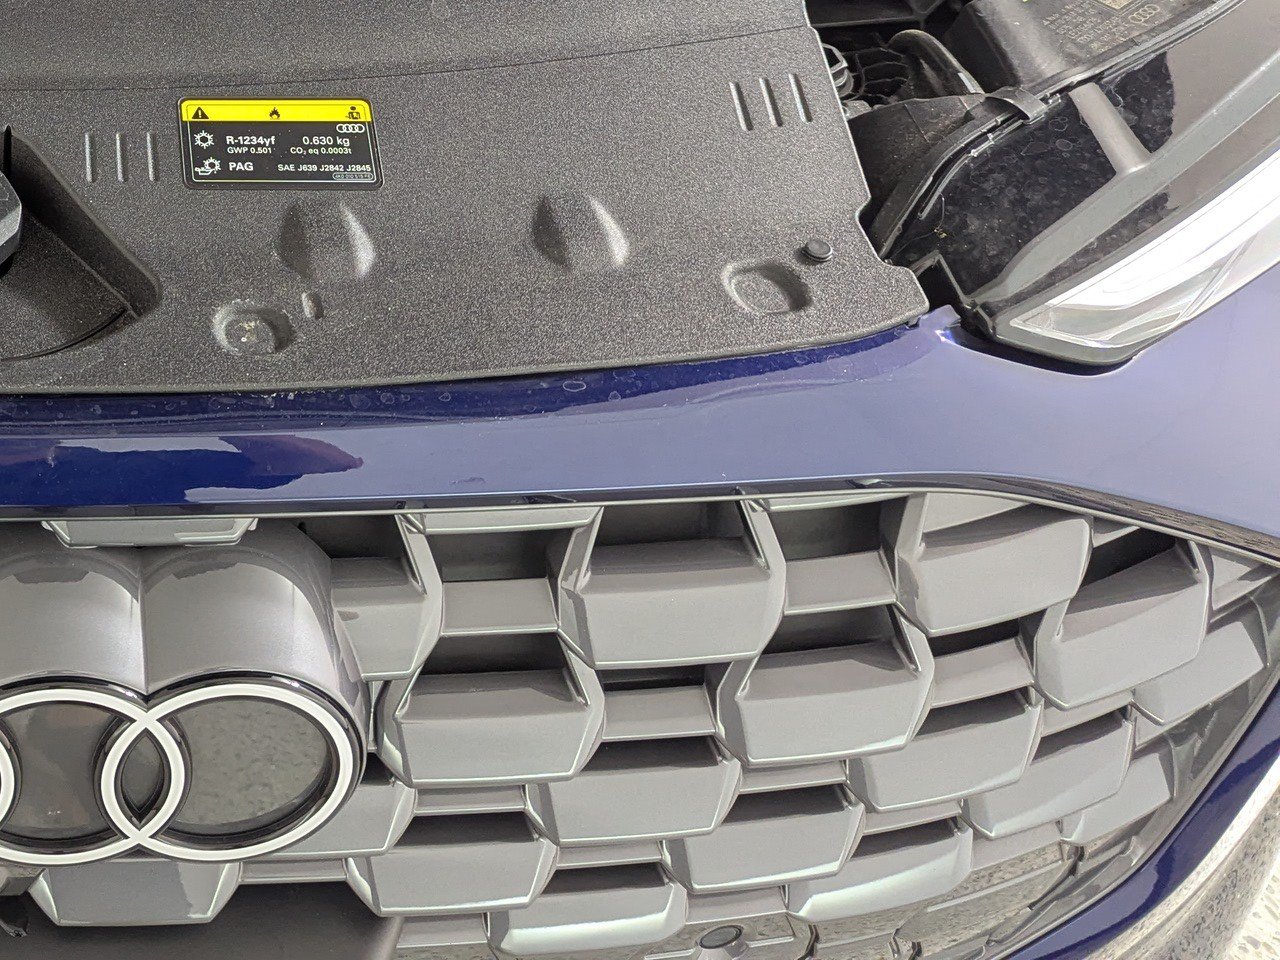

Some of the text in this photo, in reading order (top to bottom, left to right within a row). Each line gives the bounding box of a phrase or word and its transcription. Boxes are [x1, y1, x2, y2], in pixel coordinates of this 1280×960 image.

[226, 136, 275, 146] R-1234yf
[303, 137, 350, 146] 0.630 kg
[229, 162, 254, 171] PAG
